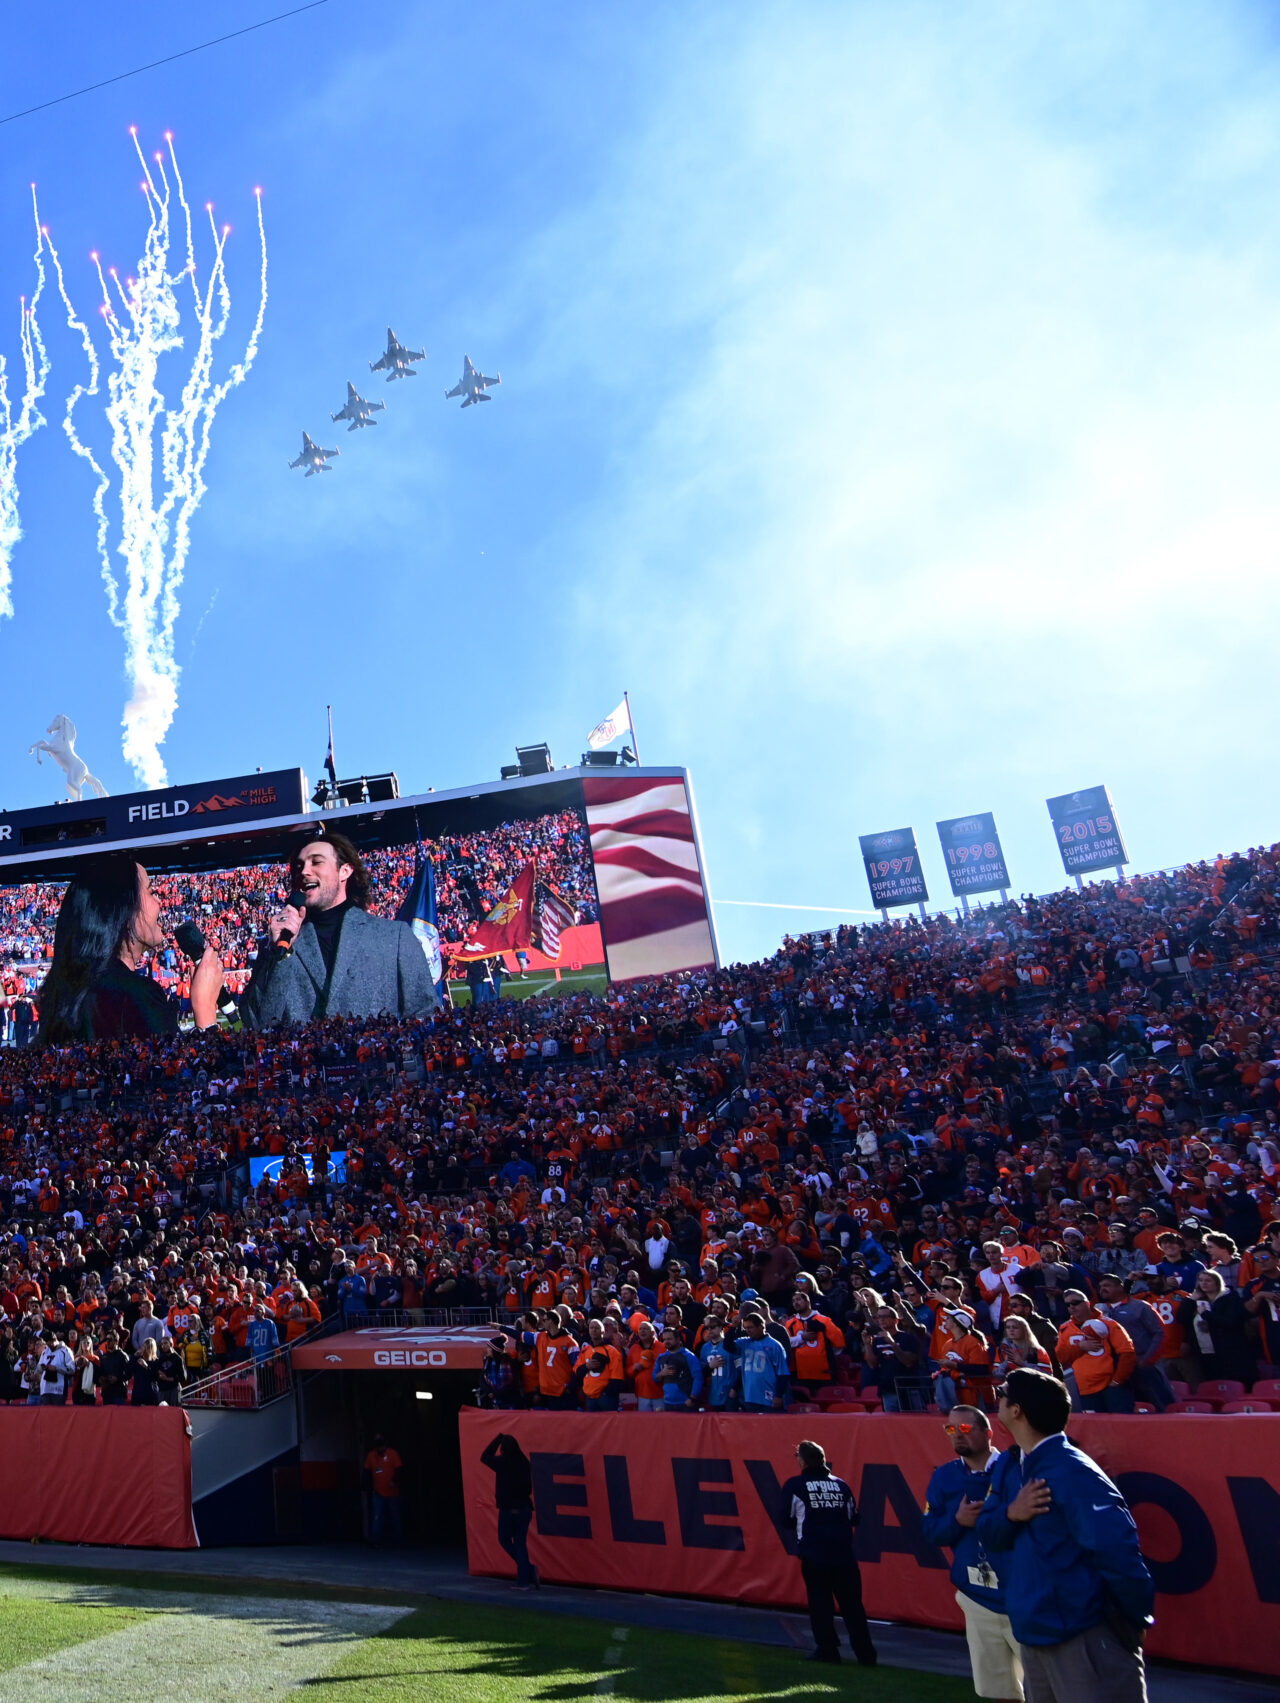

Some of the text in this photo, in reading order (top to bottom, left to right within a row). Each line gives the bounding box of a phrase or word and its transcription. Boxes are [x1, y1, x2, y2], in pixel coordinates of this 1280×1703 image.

[249, 787, 275, 798] MILE
[250, 794, 278, 806] HIGH
[127, 798, 189, 824] FIELD
[1059, 815, 1113, 843] 2015
[948, 842, 998, 865] 1998
[1063, 837, 1119, 857] SUPER BOWL
[1067, 847, 1120, 866] CHAMPIONS
[869, 856, 914, 878] 1997
[951, 861, 1004, 878] SUPER BOWL
[872, 876, 923, 892] SUPER BOWL
[954, 871, 1004, 886] CHAMPIONS
[875, 885, 923, 900] CHAMPIONS
[743, 1131, 754, 1143] 10
[548, 1165, 562, 1176] 88
[853, 1207, 869, 1223] 92
[173, 1314, 189, 1329] 88
[253, 1328, 269, 1347] 20
[373, 1350, 447, 1366] GEICO
[546, 1346, 557, 1368] 7
[744, 1349, 767, 1374] 20
[805, 1480, 841, 1493] argus
[808, 1492, 844, 1501] EVENT
[810, 1501, 845, 1509] STAFF
